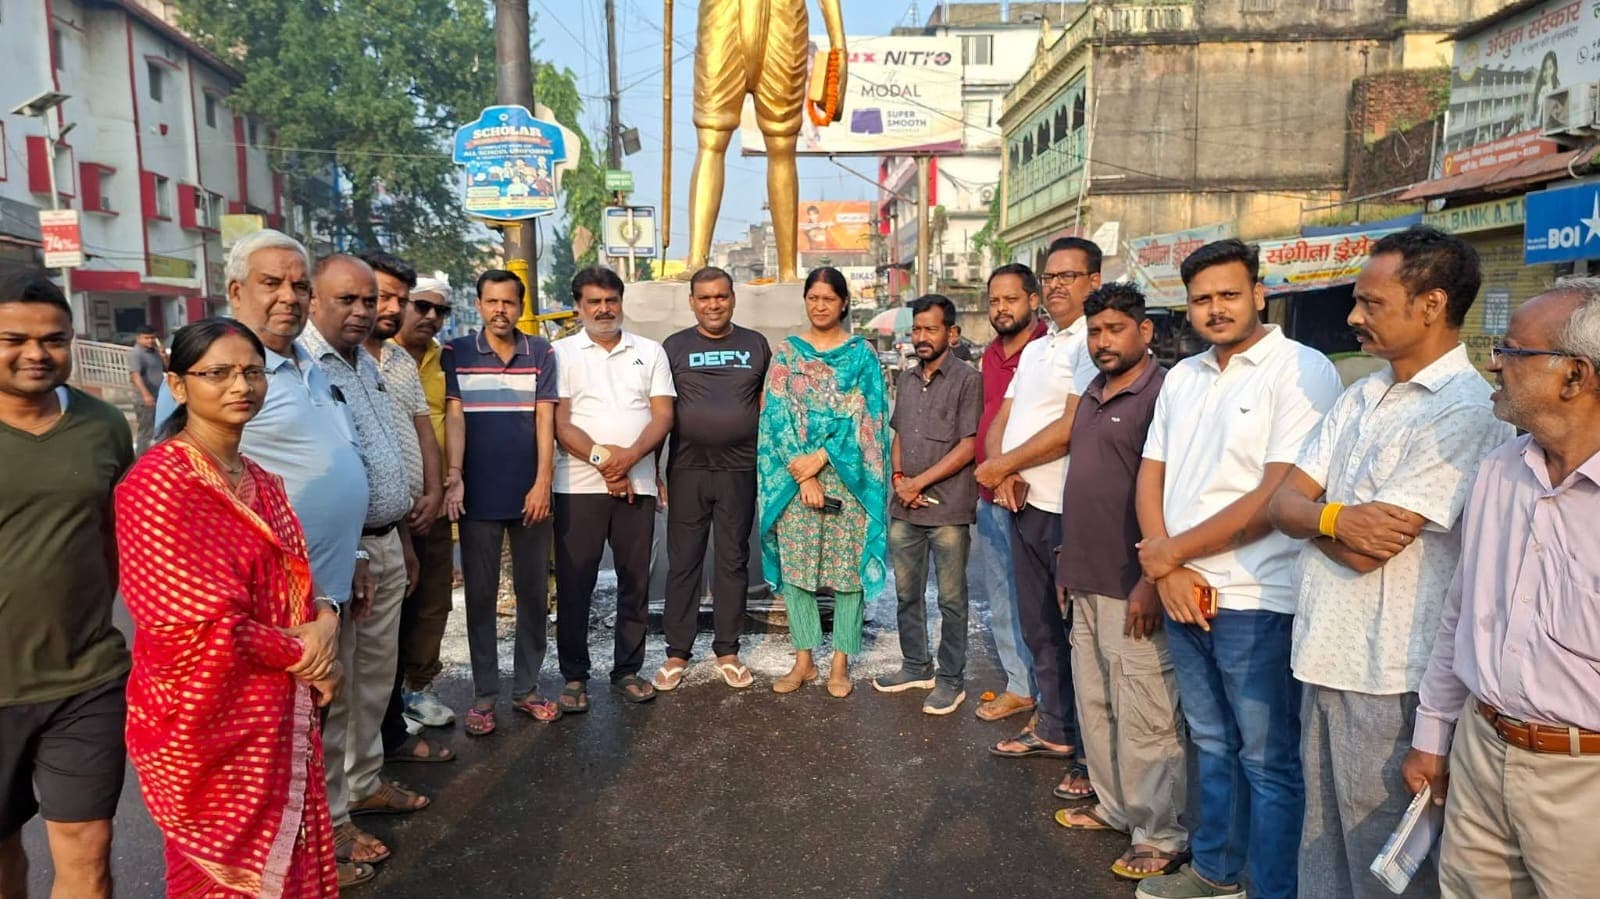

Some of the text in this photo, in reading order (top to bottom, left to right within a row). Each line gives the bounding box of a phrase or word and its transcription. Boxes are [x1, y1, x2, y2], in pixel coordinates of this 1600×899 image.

[1486, 25, 1524, 58] अंजुम
[1528, 1, 1584, 39] संस्कार
[884, 50, 952, 66] NITRO
[861, 84, 922, 97] MODAL
[472, 125, 542, 139] SCHOLAR
[509, 148, 554, 156] UNIFORMS
[1451, 206, 1489, 231] BANK
[1494, 200, 1526, 225] A.T.
[1548, 225, 1580, 249] BOI
[1266, 240, 1331, 263] संगीता
[689, 350, 751, 367] DEFY
